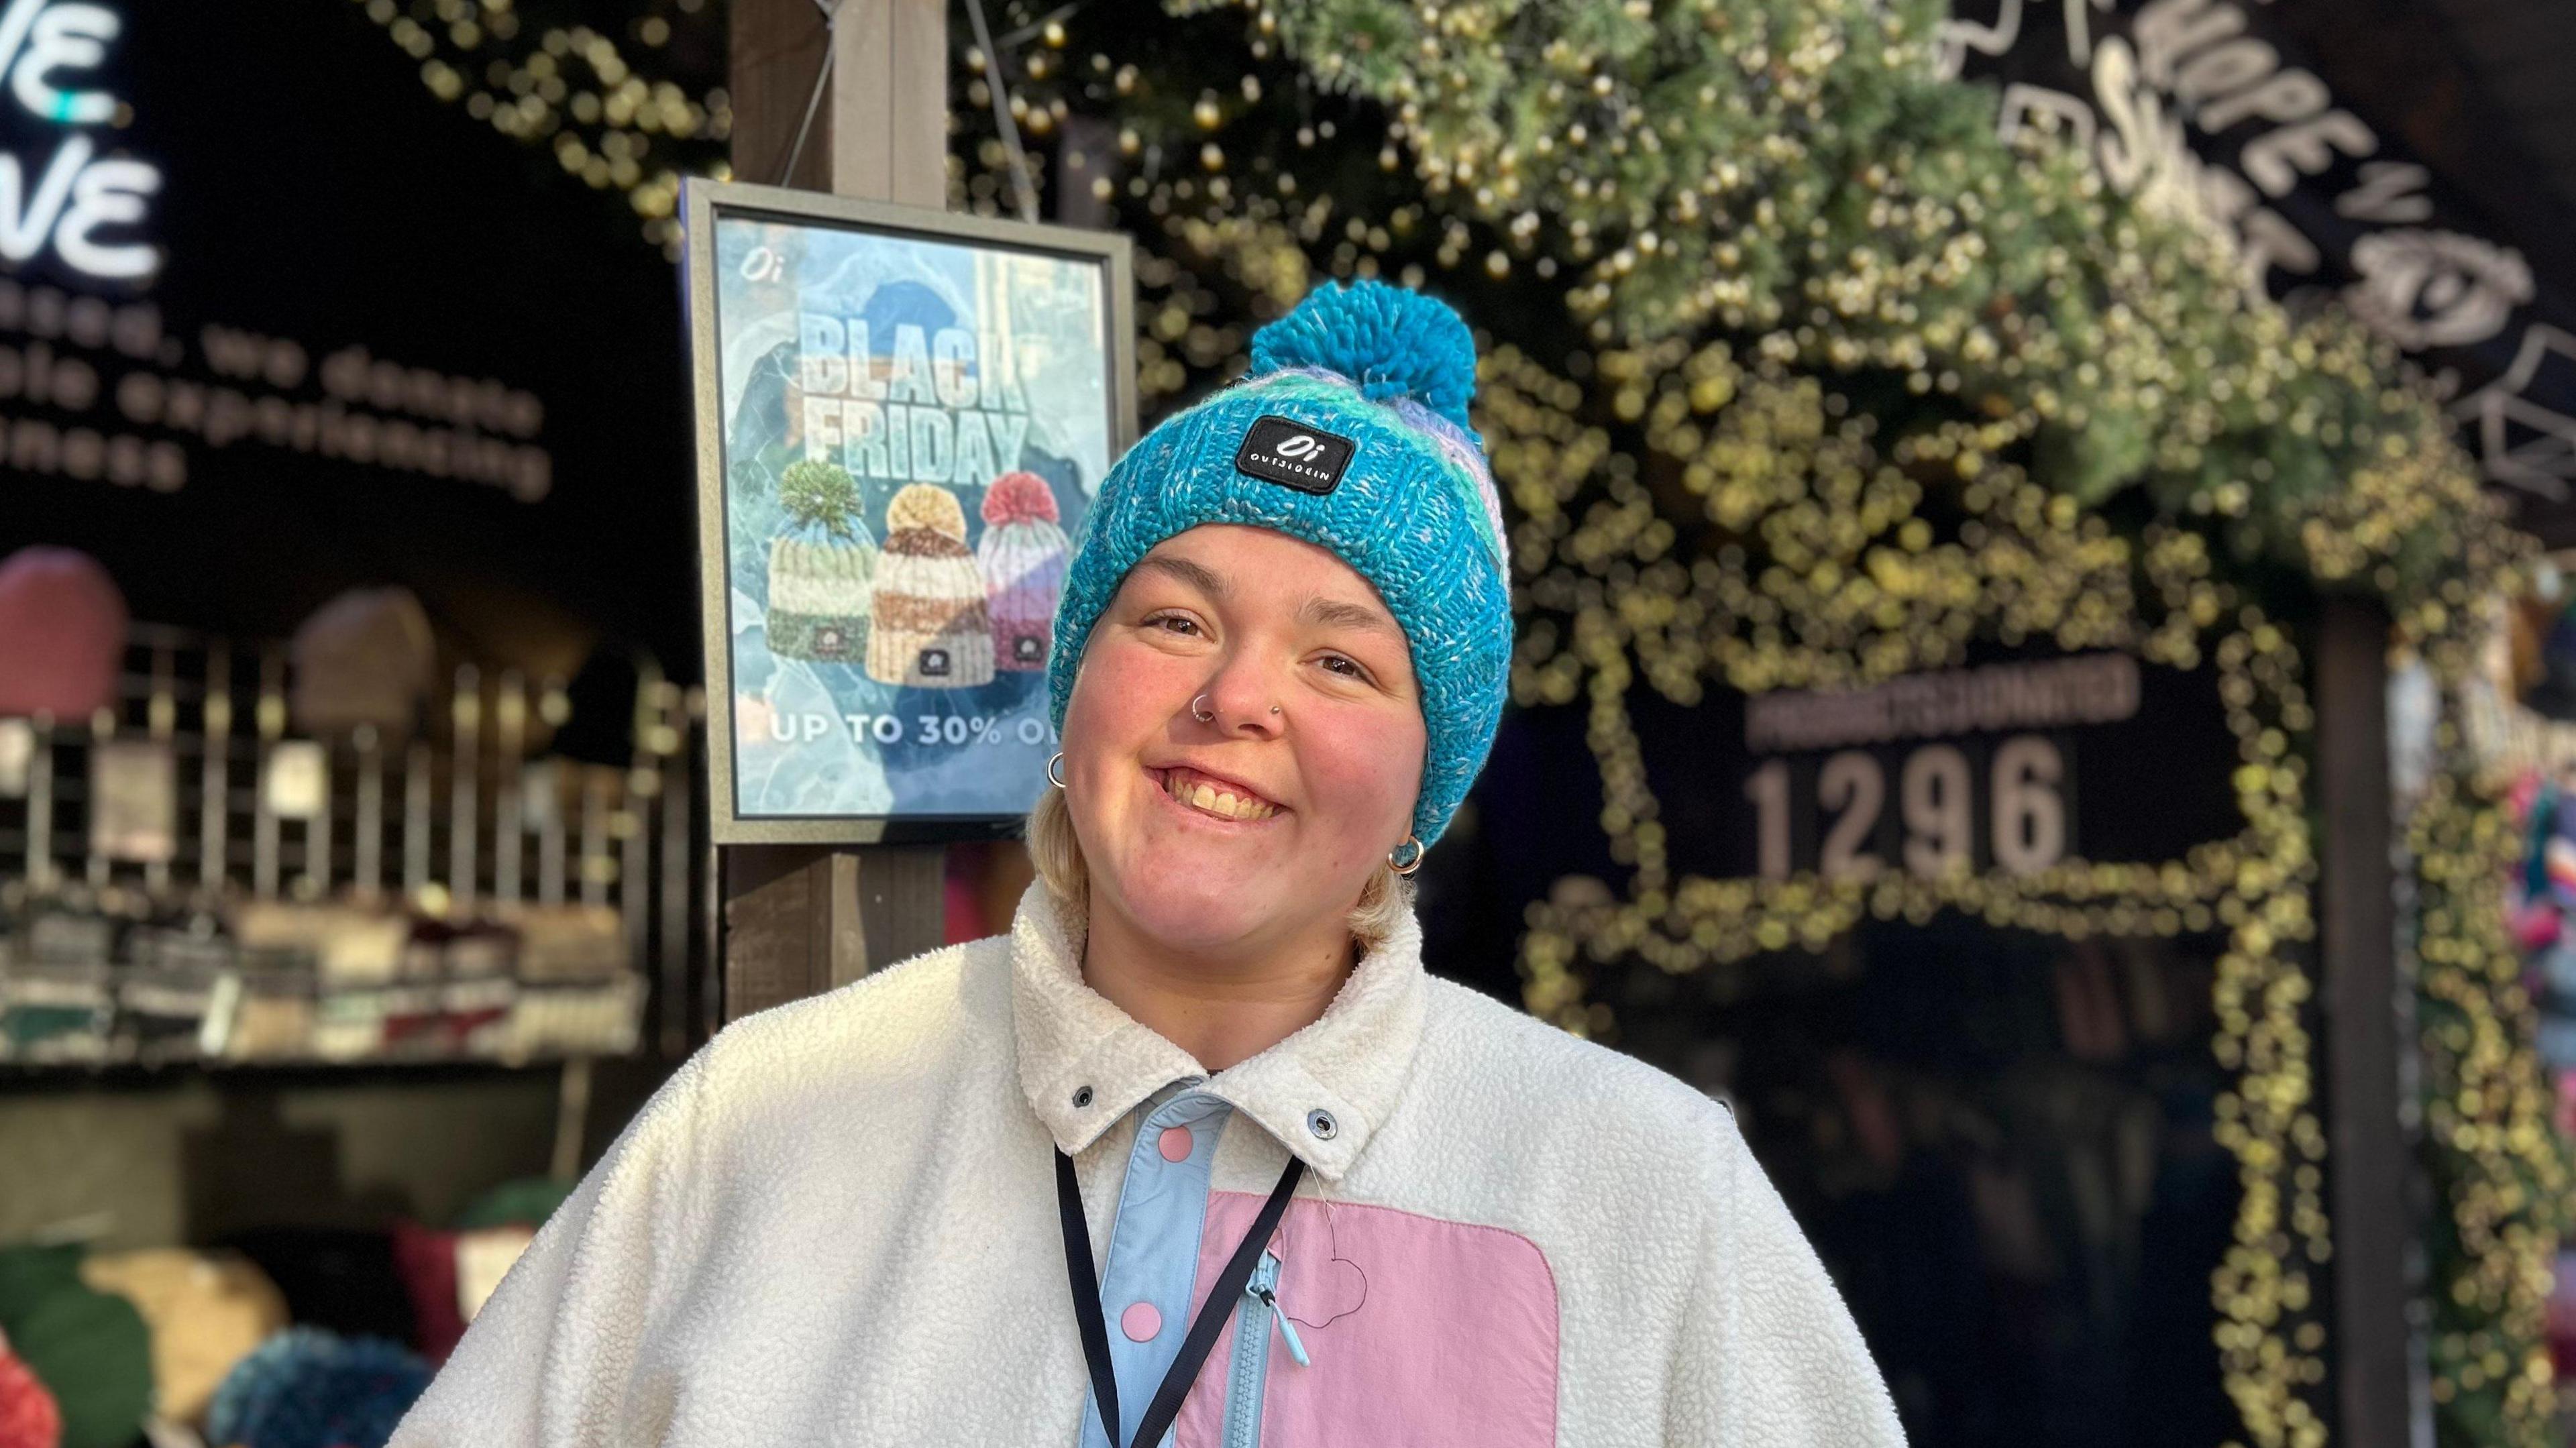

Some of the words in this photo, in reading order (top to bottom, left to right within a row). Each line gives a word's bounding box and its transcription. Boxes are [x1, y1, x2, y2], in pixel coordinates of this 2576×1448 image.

[800, 313, 1028, 412] BLACK
[804, 396, 1029, 486] FRIDAY
[1277, 435, 1326, 461] Oi
[769, 714, 828, 742] UP
[846, 714, 903, 744] TO
[918, 715, 1002, 745] 30%
[1744, 736, 2068, 884] 1296
